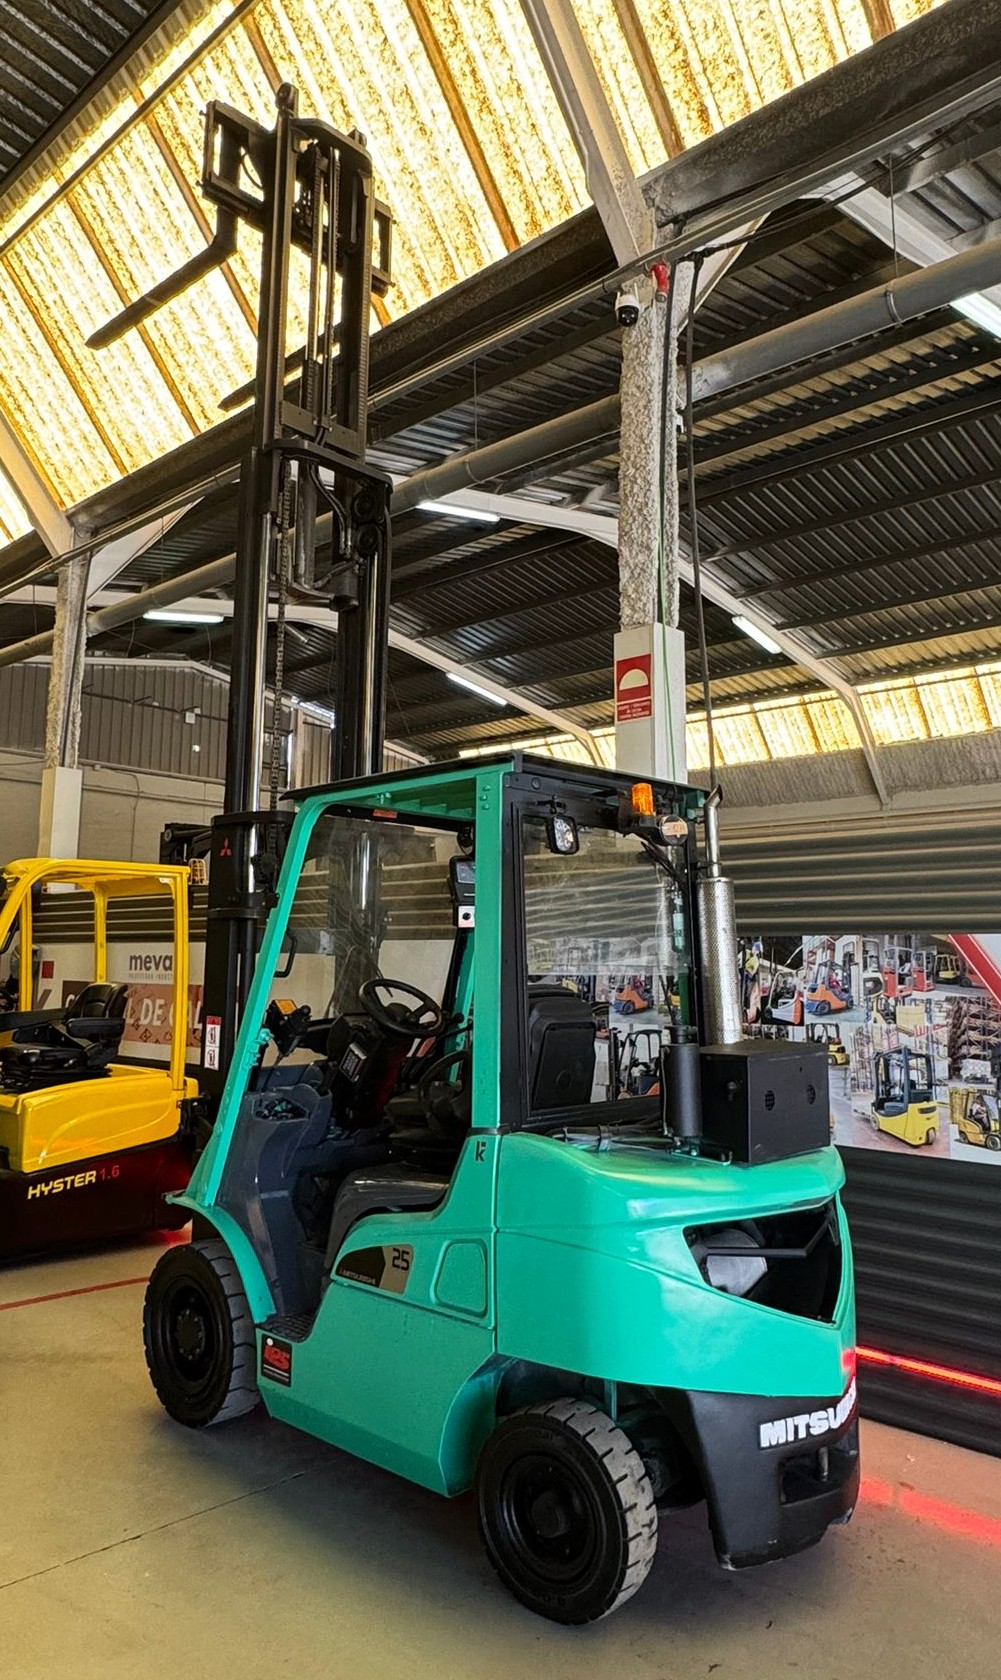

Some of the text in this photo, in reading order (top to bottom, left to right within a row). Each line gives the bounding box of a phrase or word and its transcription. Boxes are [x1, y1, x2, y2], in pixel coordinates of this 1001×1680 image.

[140, 998, 165, 1026] DE
[27, 1165, 120, 1200] HYSTER 1.6
[392, 1247, 410, 1271] 25
